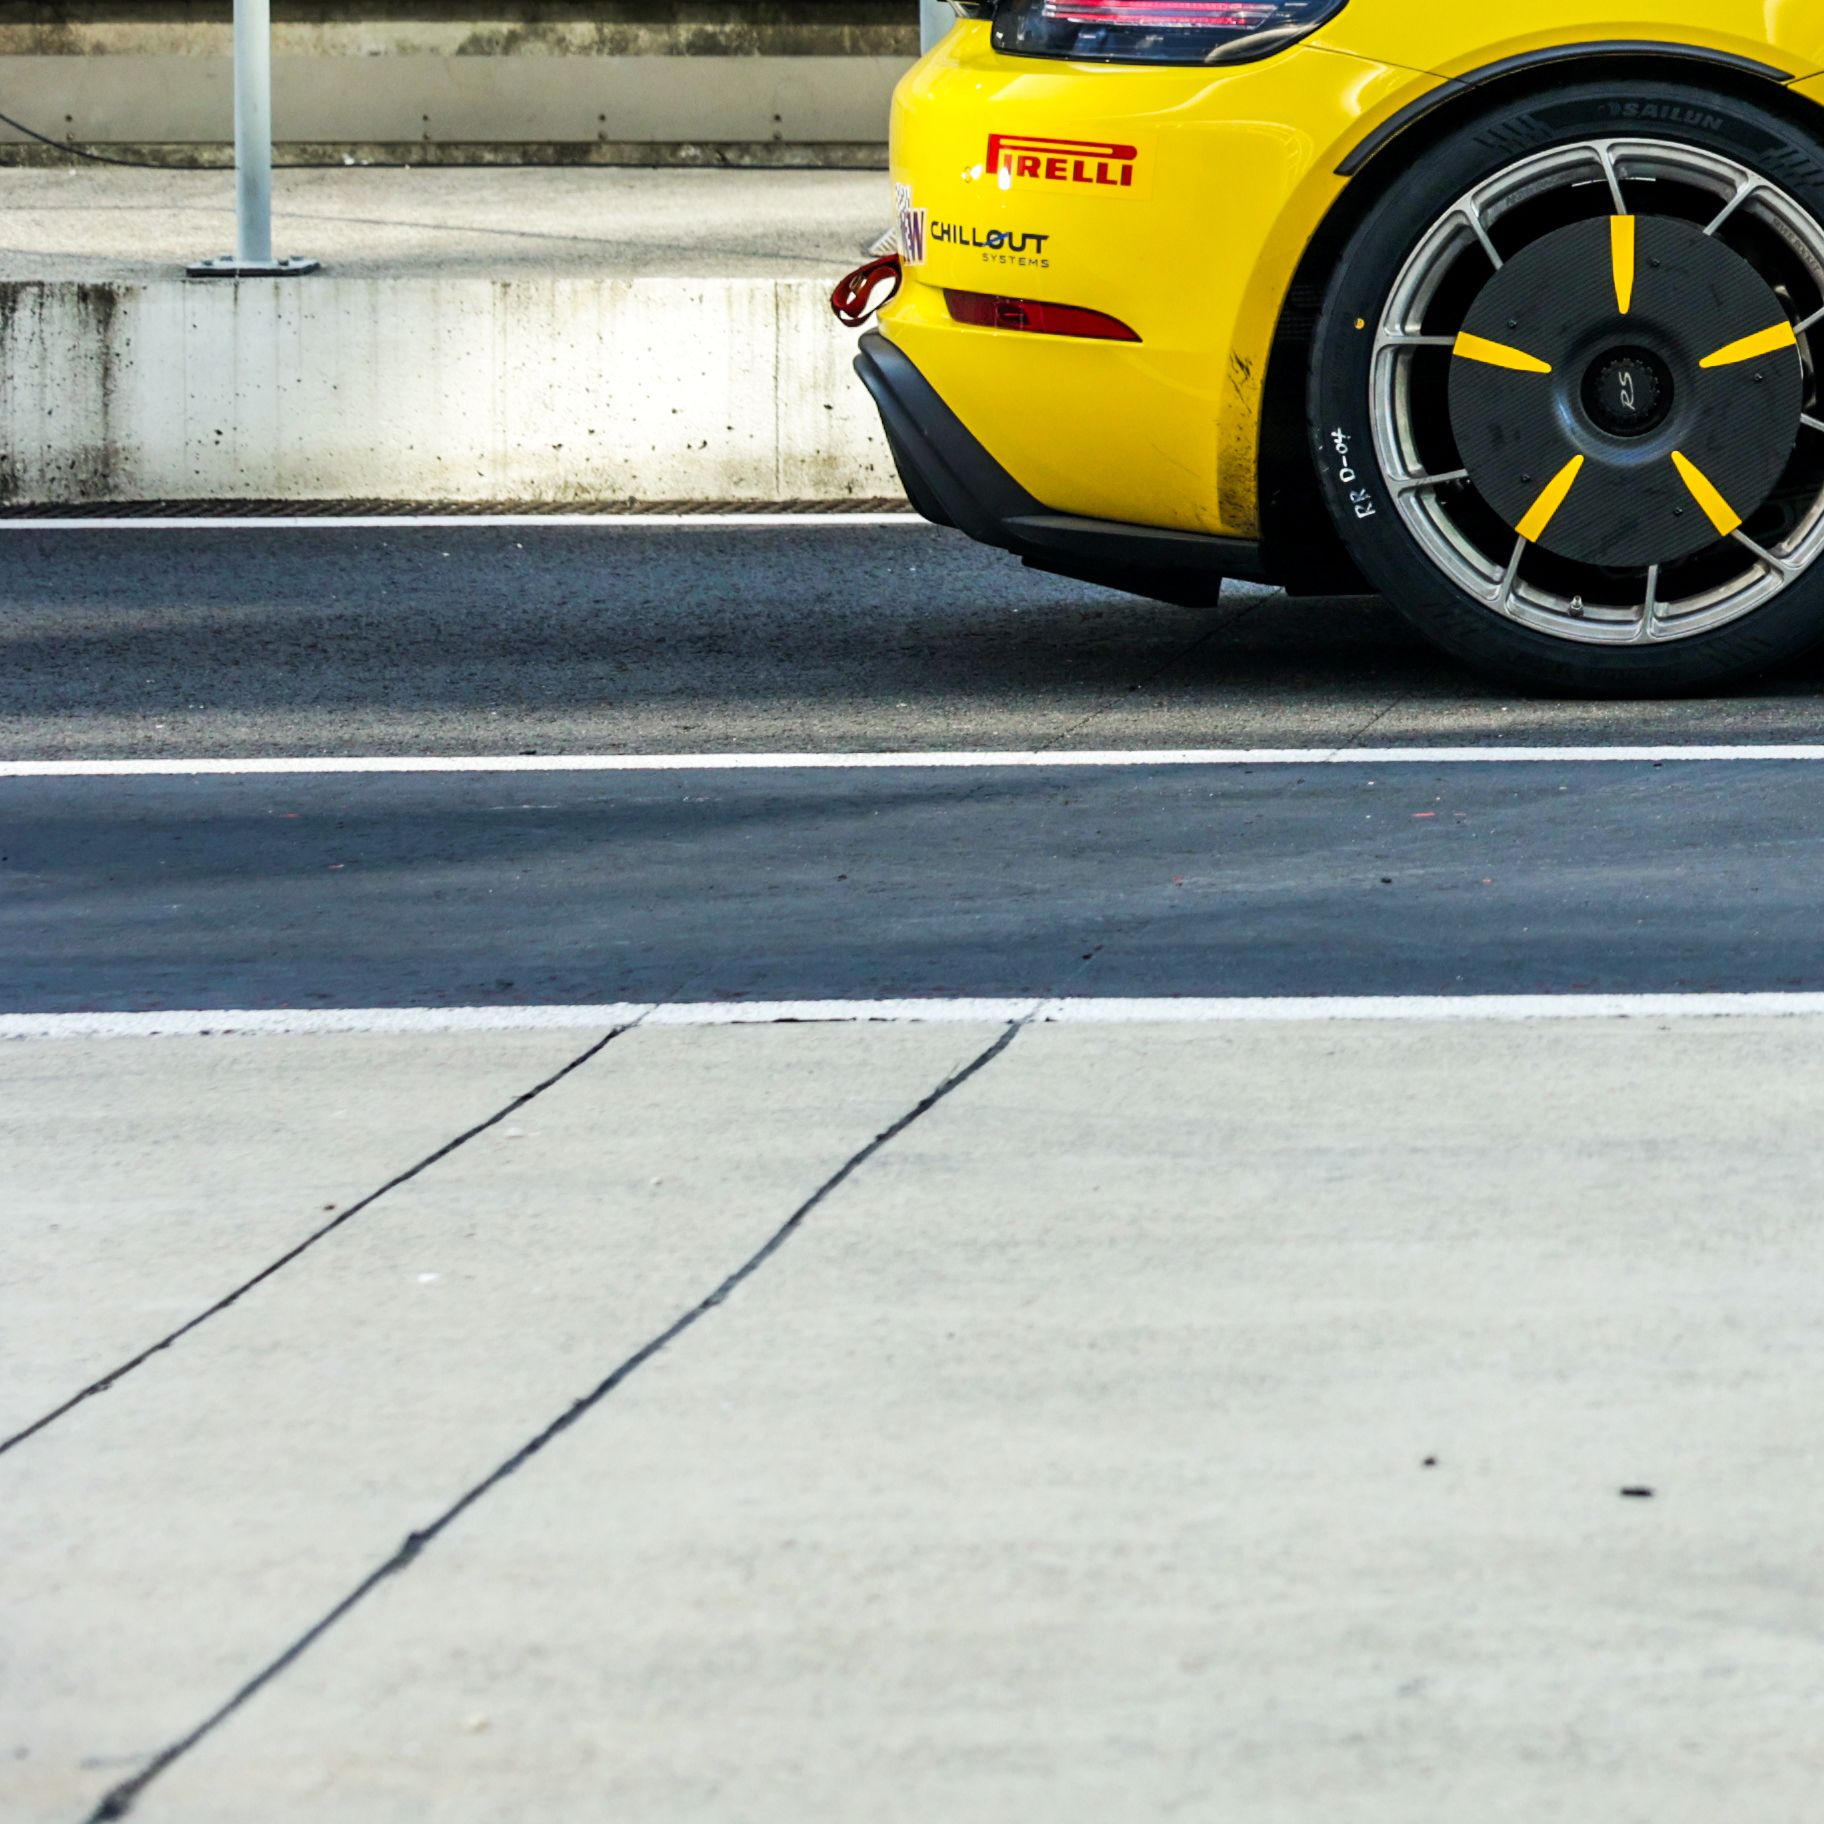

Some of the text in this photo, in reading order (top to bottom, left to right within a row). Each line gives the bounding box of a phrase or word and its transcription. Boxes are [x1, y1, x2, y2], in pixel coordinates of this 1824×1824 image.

[1622, 102, 1725, 131] SAILUN
[986, 133, 1138, 187] PIRELLI
[931, 220, 1050, 254] CHILLOUT
[982, 252, 1050, 268] SYSTEMS
[1331, 427, 1355, 483] D-04
[1350, 488, 1376, 518] RR
